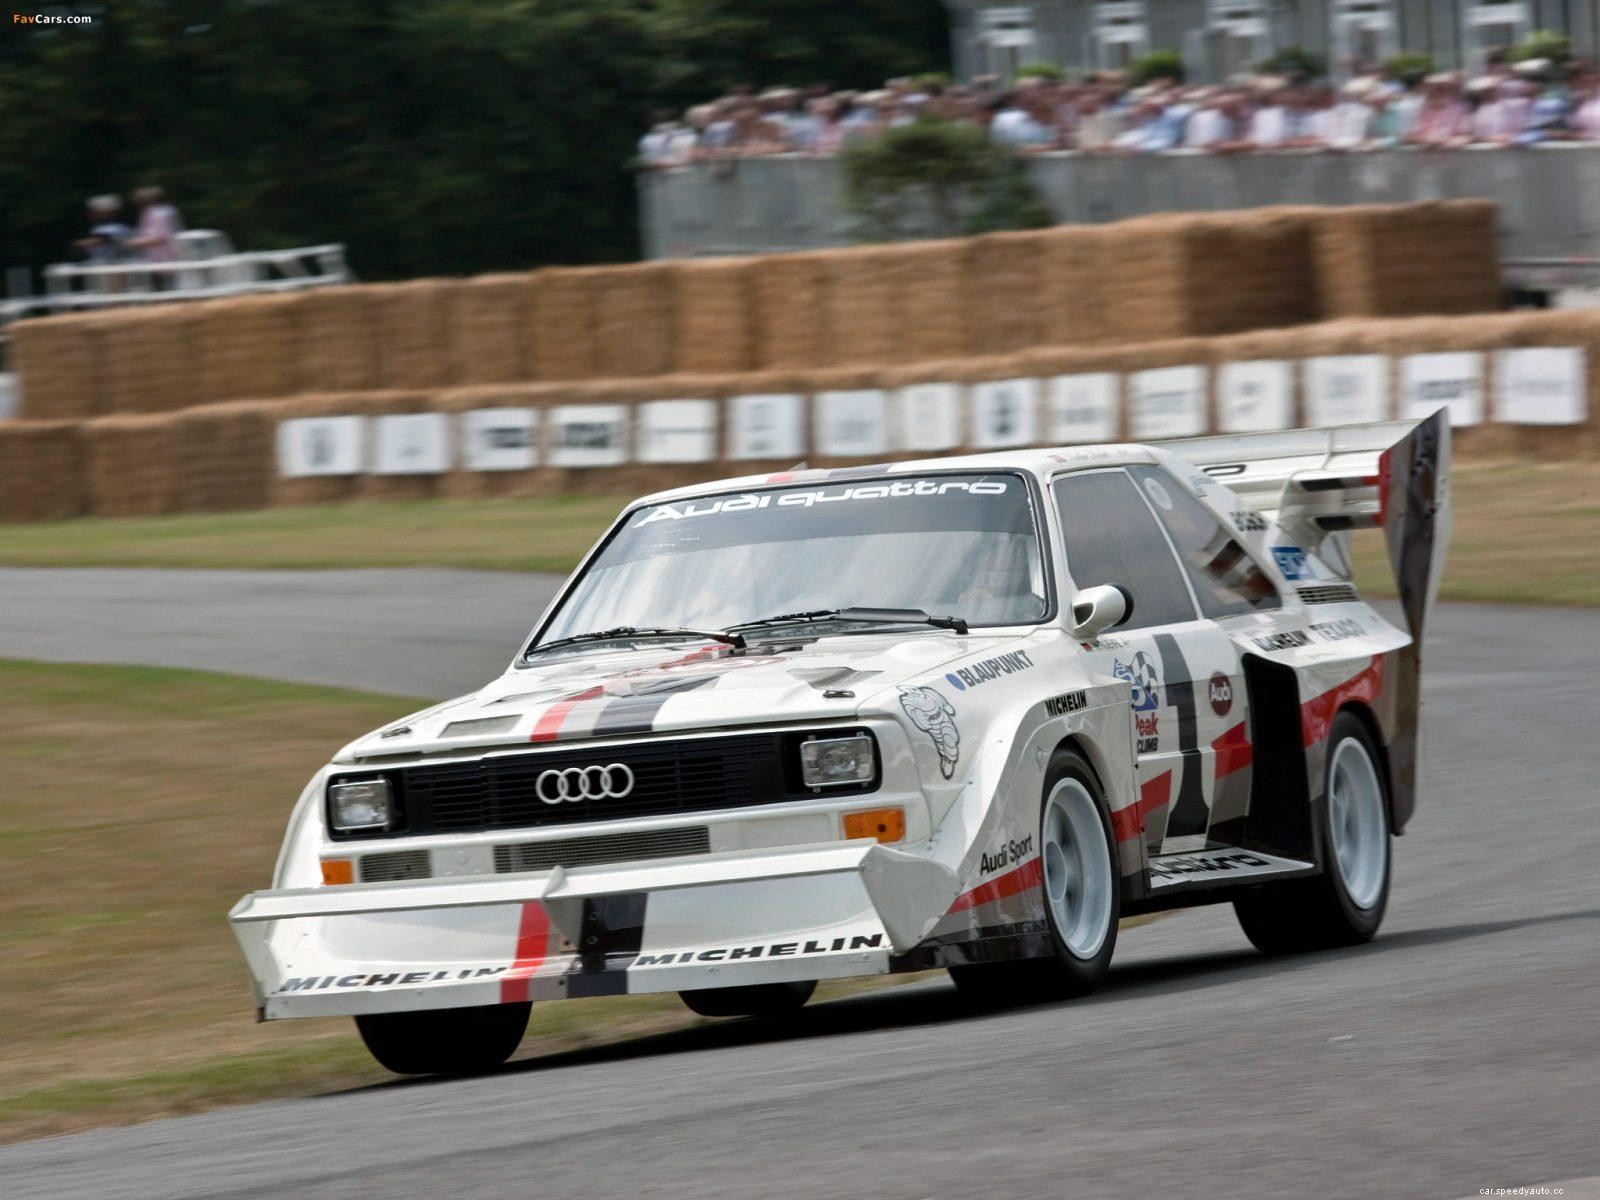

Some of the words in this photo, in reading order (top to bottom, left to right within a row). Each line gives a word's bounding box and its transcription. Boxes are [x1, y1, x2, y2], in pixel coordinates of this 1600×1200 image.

[633, 494, 769, 528] Audi
[777, 475, 1008, 508] quattro
[956, 650, 1035, 688] BLAUPUNKT
[1045, 690, 1088, 717] MICHELIN
[1210, 681, 1232, 702] Audi
[980, 844, 1008, 876] Audi
[1009, 832, 1033, 866] Sport
[636, 933, 883, 966] MICHELIN
[276, 966, 508, 993] MICHELIN
